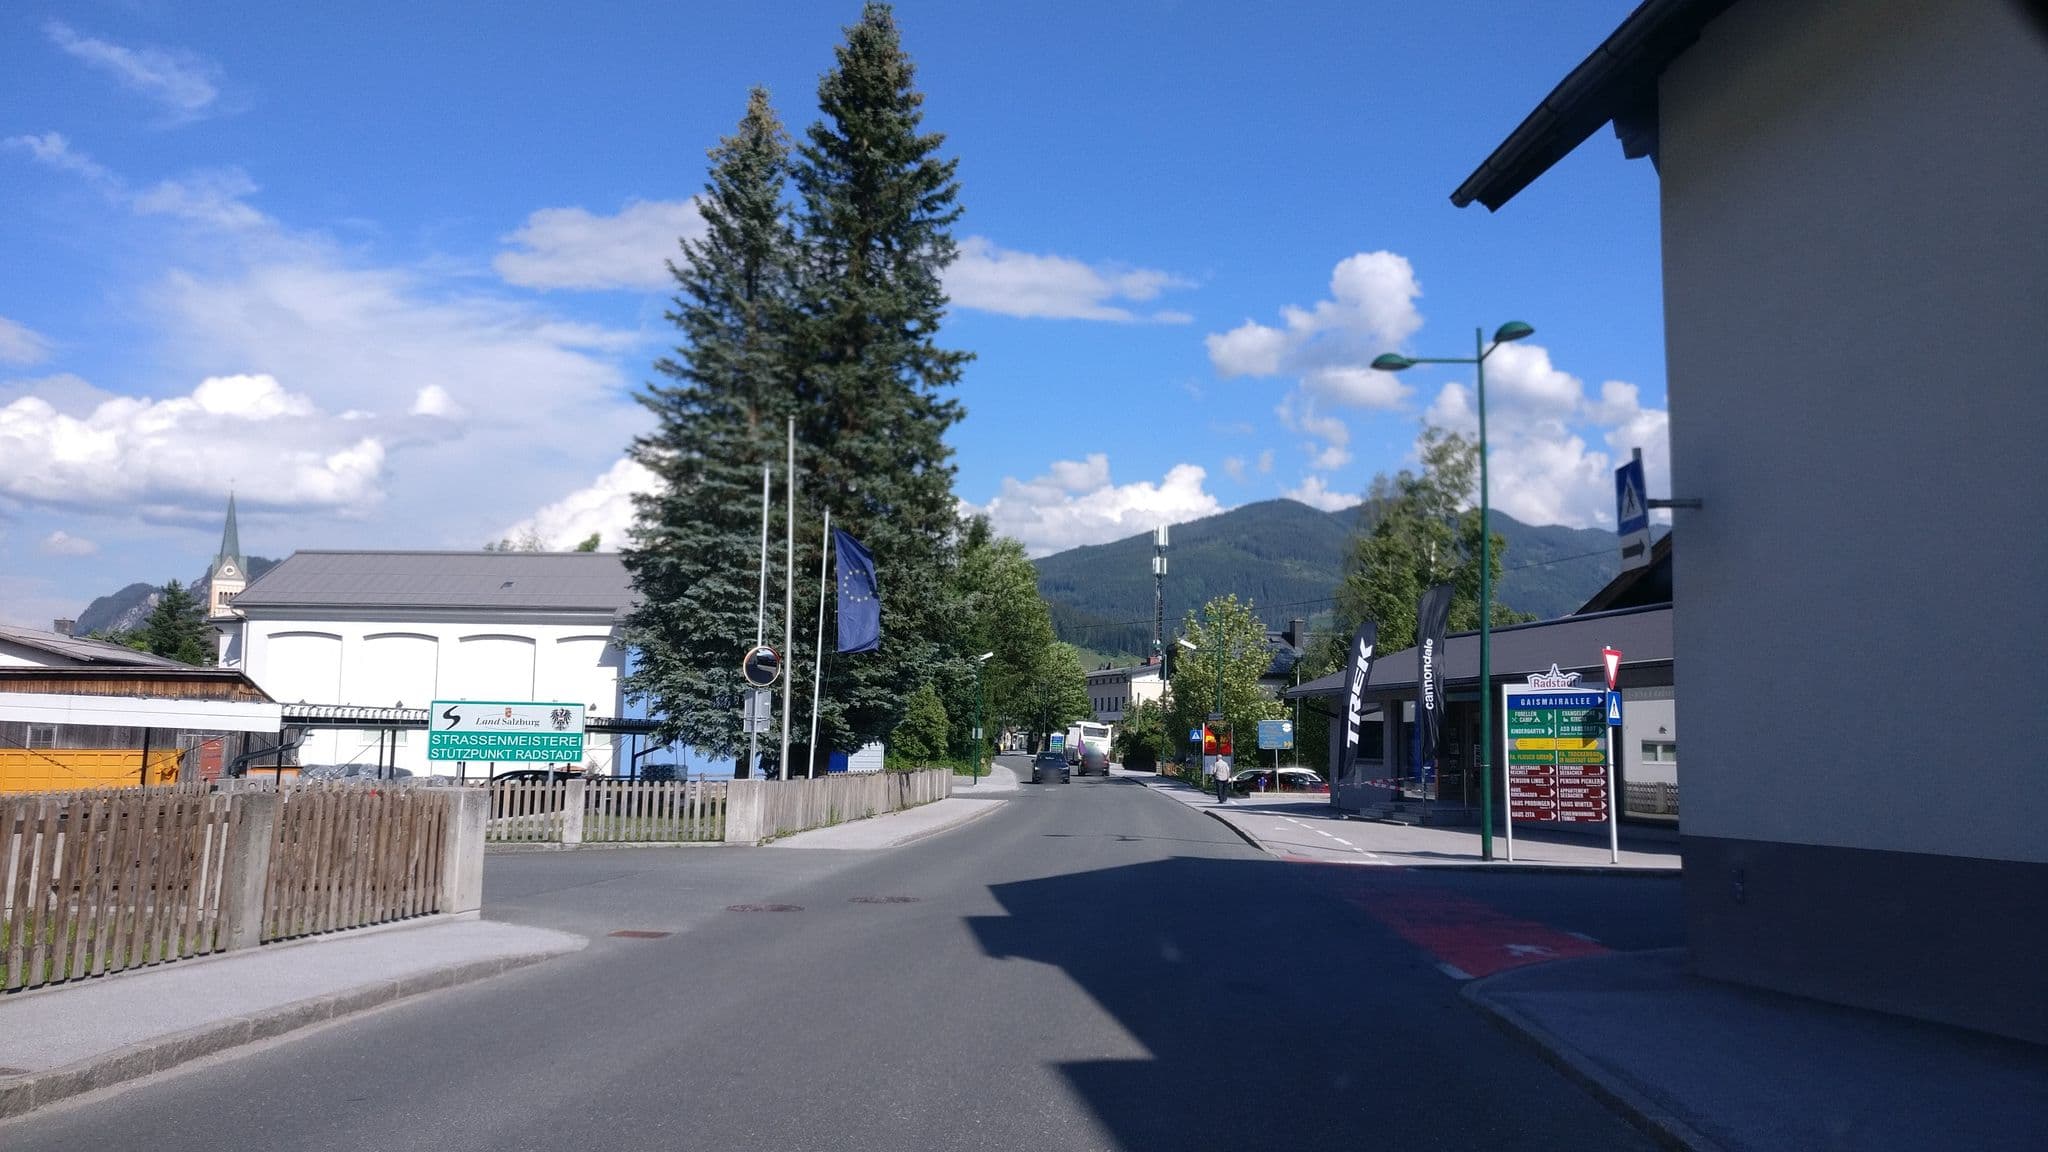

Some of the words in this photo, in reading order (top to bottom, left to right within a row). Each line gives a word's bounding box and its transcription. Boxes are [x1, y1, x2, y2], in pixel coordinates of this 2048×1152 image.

[1423, 638, 1434, 710] cannondale
[1533, 678, 1577, 688] Radstadt
[1347, 637, 1373, 748] TREK
[1520, 697, 1591, 706] GAISMAIRALLEE
[475, 717, 501, 726] Land
[501, 718, 541, 727] Salzburg
[431, 734, 581, 747] STRASSENMEISTEREI
[431, 747, 512, 759] STÜTZPUNKT
[515, 750, 580, 760] RADSTADT
